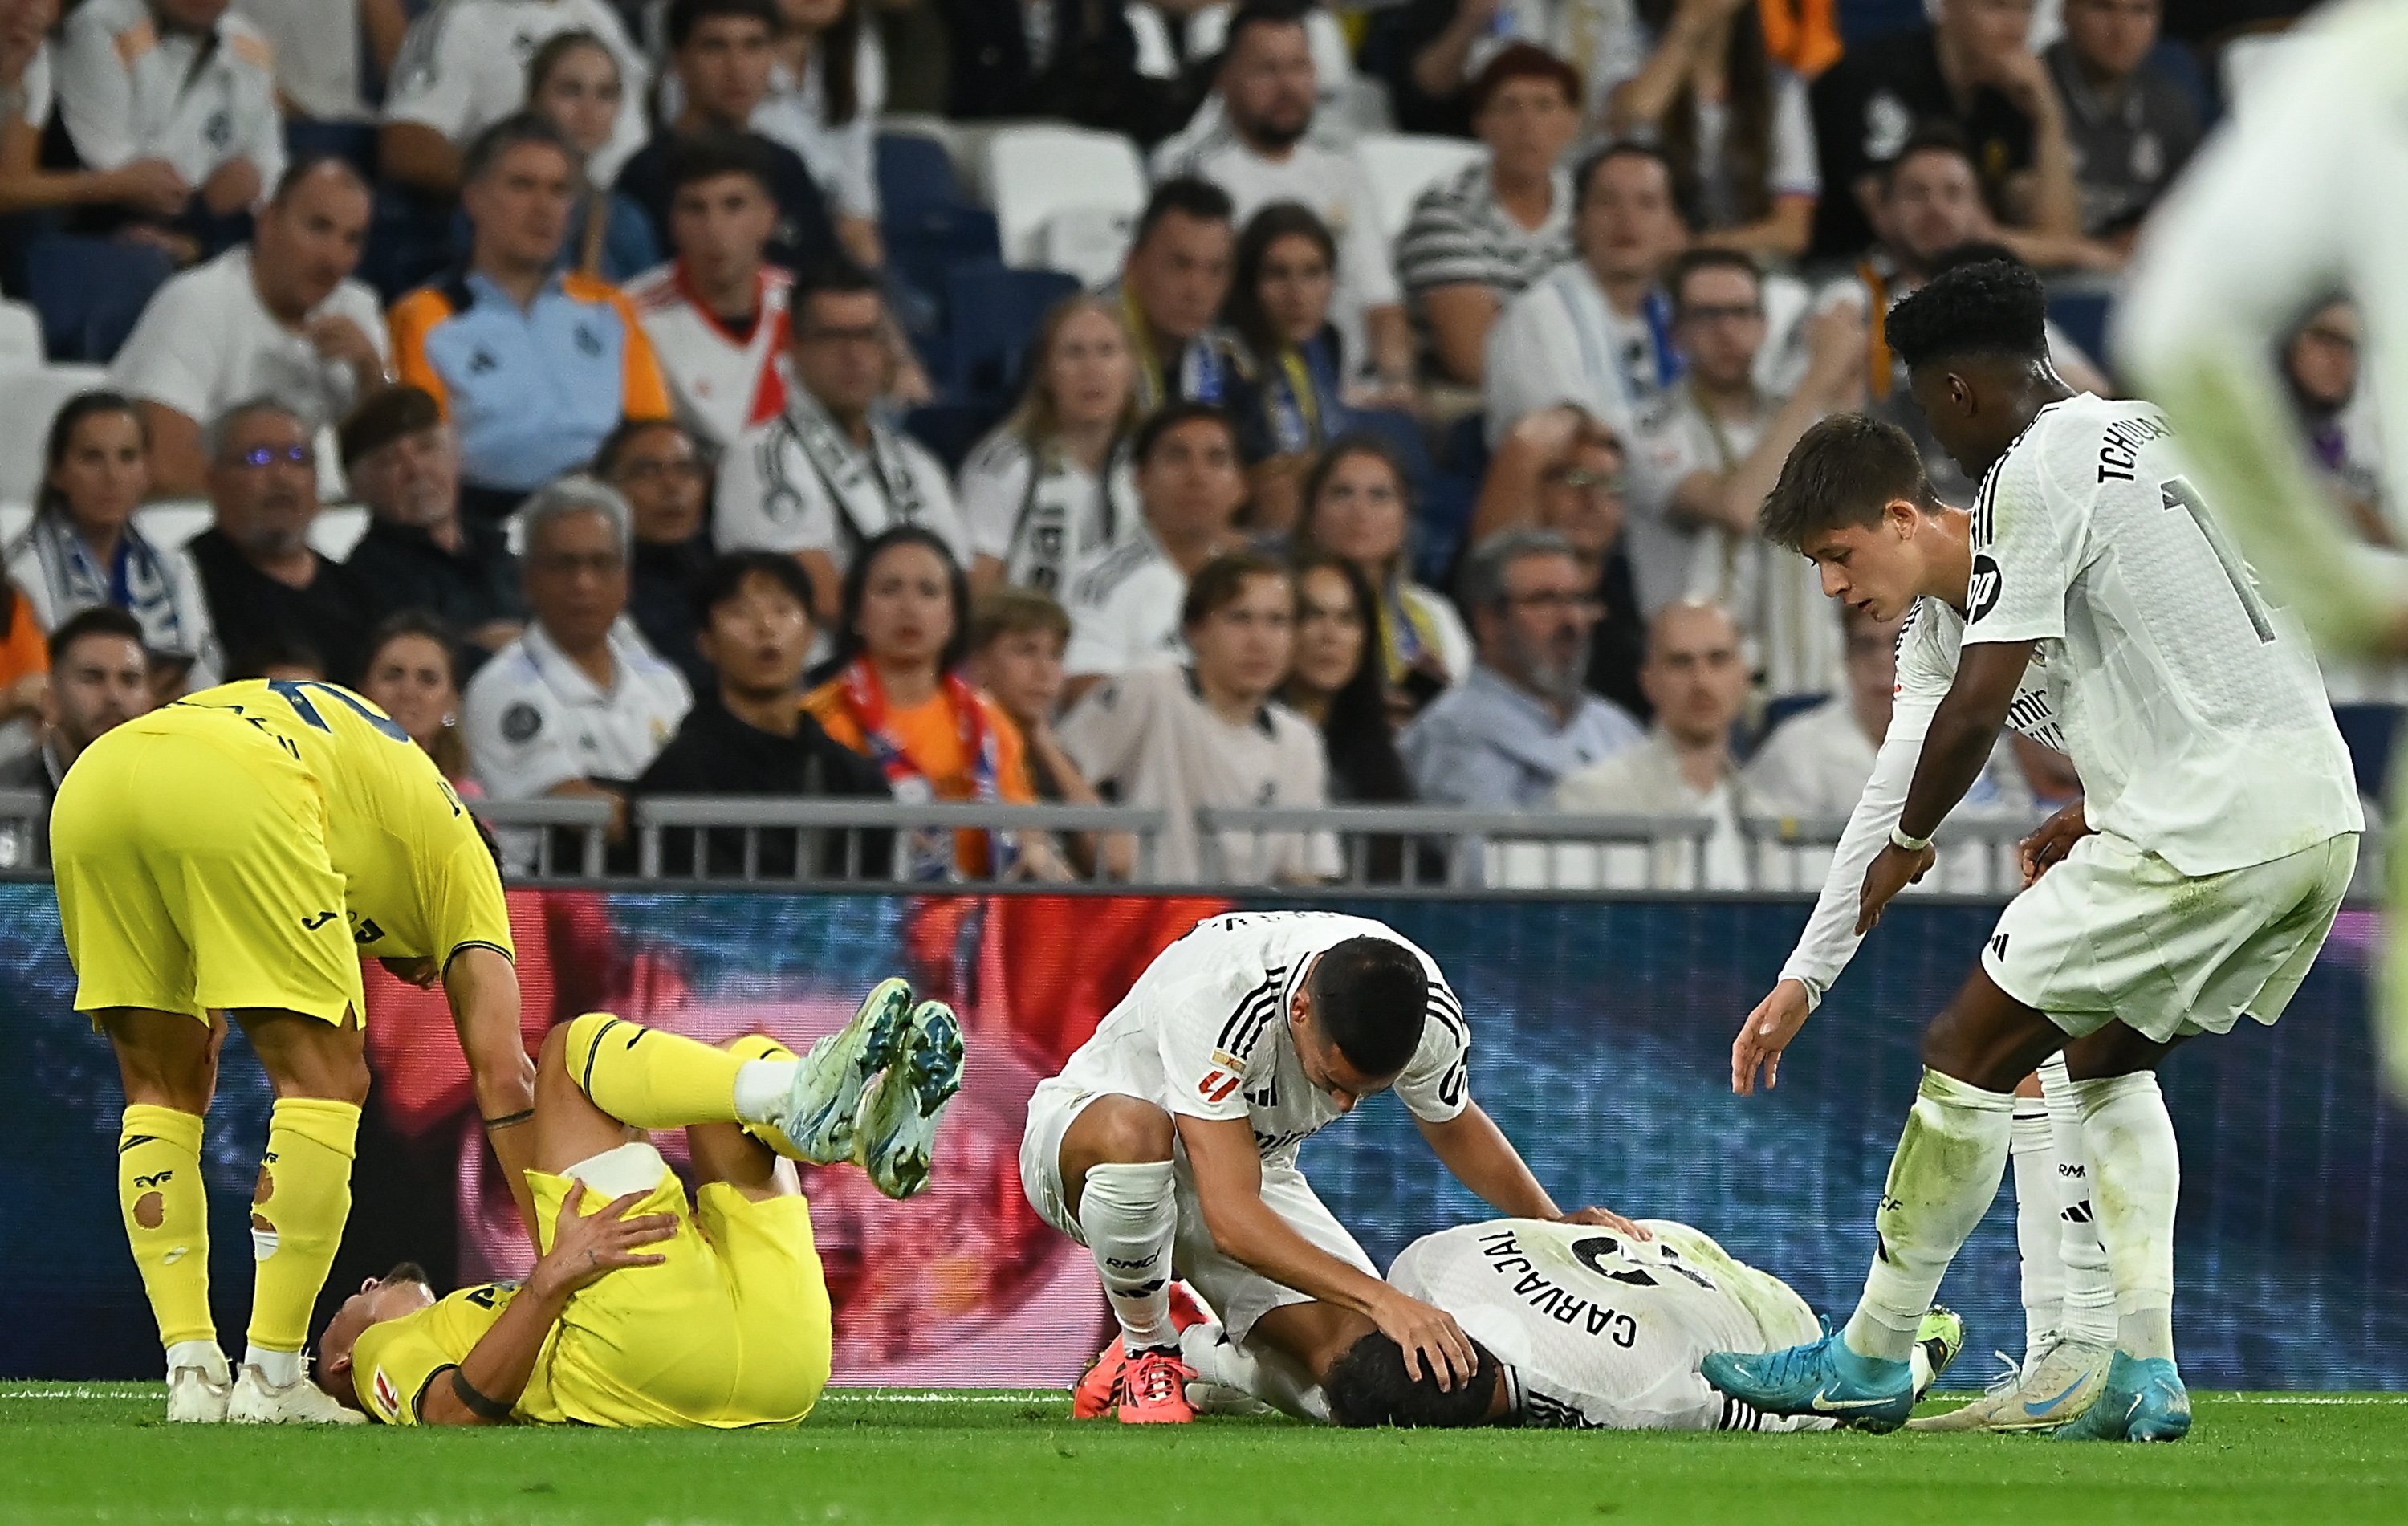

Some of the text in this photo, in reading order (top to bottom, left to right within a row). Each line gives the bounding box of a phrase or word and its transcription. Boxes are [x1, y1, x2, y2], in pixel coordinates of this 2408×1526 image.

[2097, 415, 2176, 483] TCHOUA
[2008, 687, 2052, 729] mir
[1479, 1229, 1637, 1349] CARVAJAL
